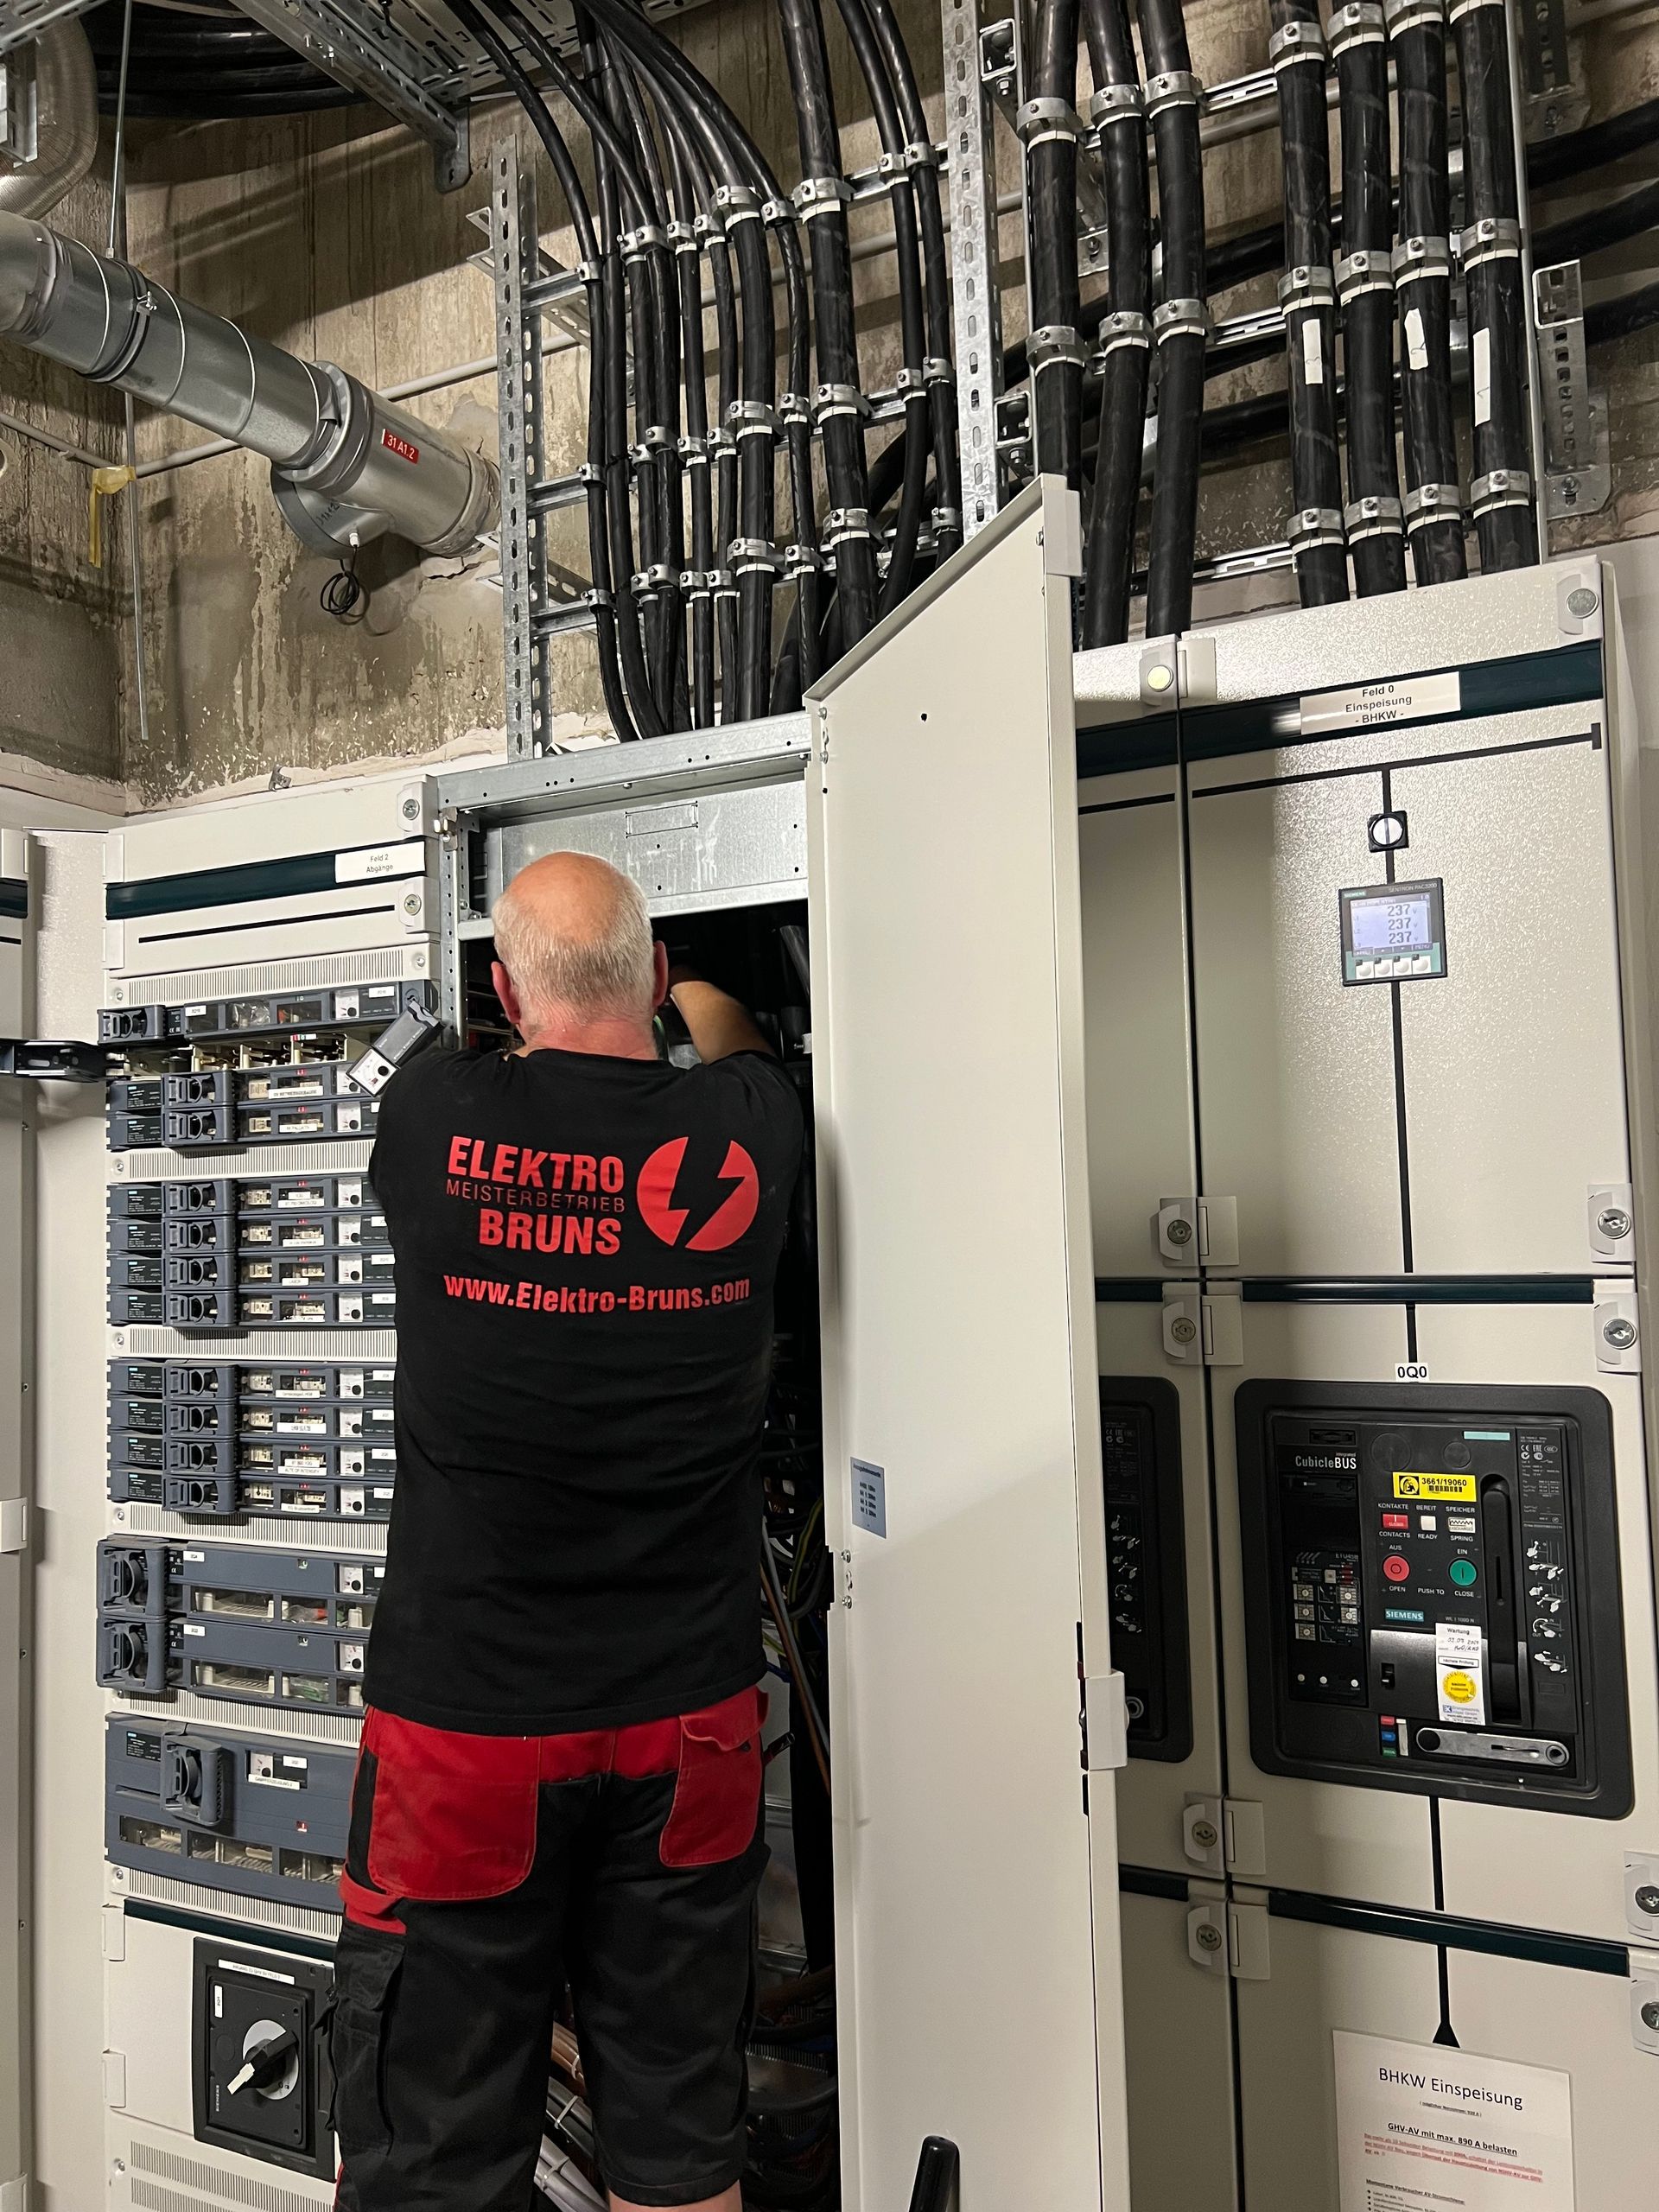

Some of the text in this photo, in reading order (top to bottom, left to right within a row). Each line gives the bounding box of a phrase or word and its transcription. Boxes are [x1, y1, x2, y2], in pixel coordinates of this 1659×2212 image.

[1362, 684, 1395, 697] Feld 0
[1345, 696, 1413, 713] Einspeisung
[1362, 709, 1397, 724] BHKW
[1388, 903, 1411, 917] 237
[1388, 917, 1412, 931] 237
[1389, 931, 1412, 944] 237
[447, 1135, 625, 1193] ELEKTRO
[446, 1179, 626, 1213] MEISTERBETRIEB
[479, 1208, 621, 1255] BRUNS
[443, 1274, 750, 1314] www.Elektro-Bruns.com
[1295, 1455, 1357, 1470] CubicleBUS
[1421, 1478, 1467, 1486] 3661/19060
[1385, 1611, 1424, 1620] SIEMENS
[1447, 1627, 1470, 1636] Wartung
[1379, 2067, 1426, 2088] BHKW
[1431, 2077, 1523, 2111] Einspeisung
[1388, 2122, 1518, 2156] GHV-AV mit max. 890 A belasten
